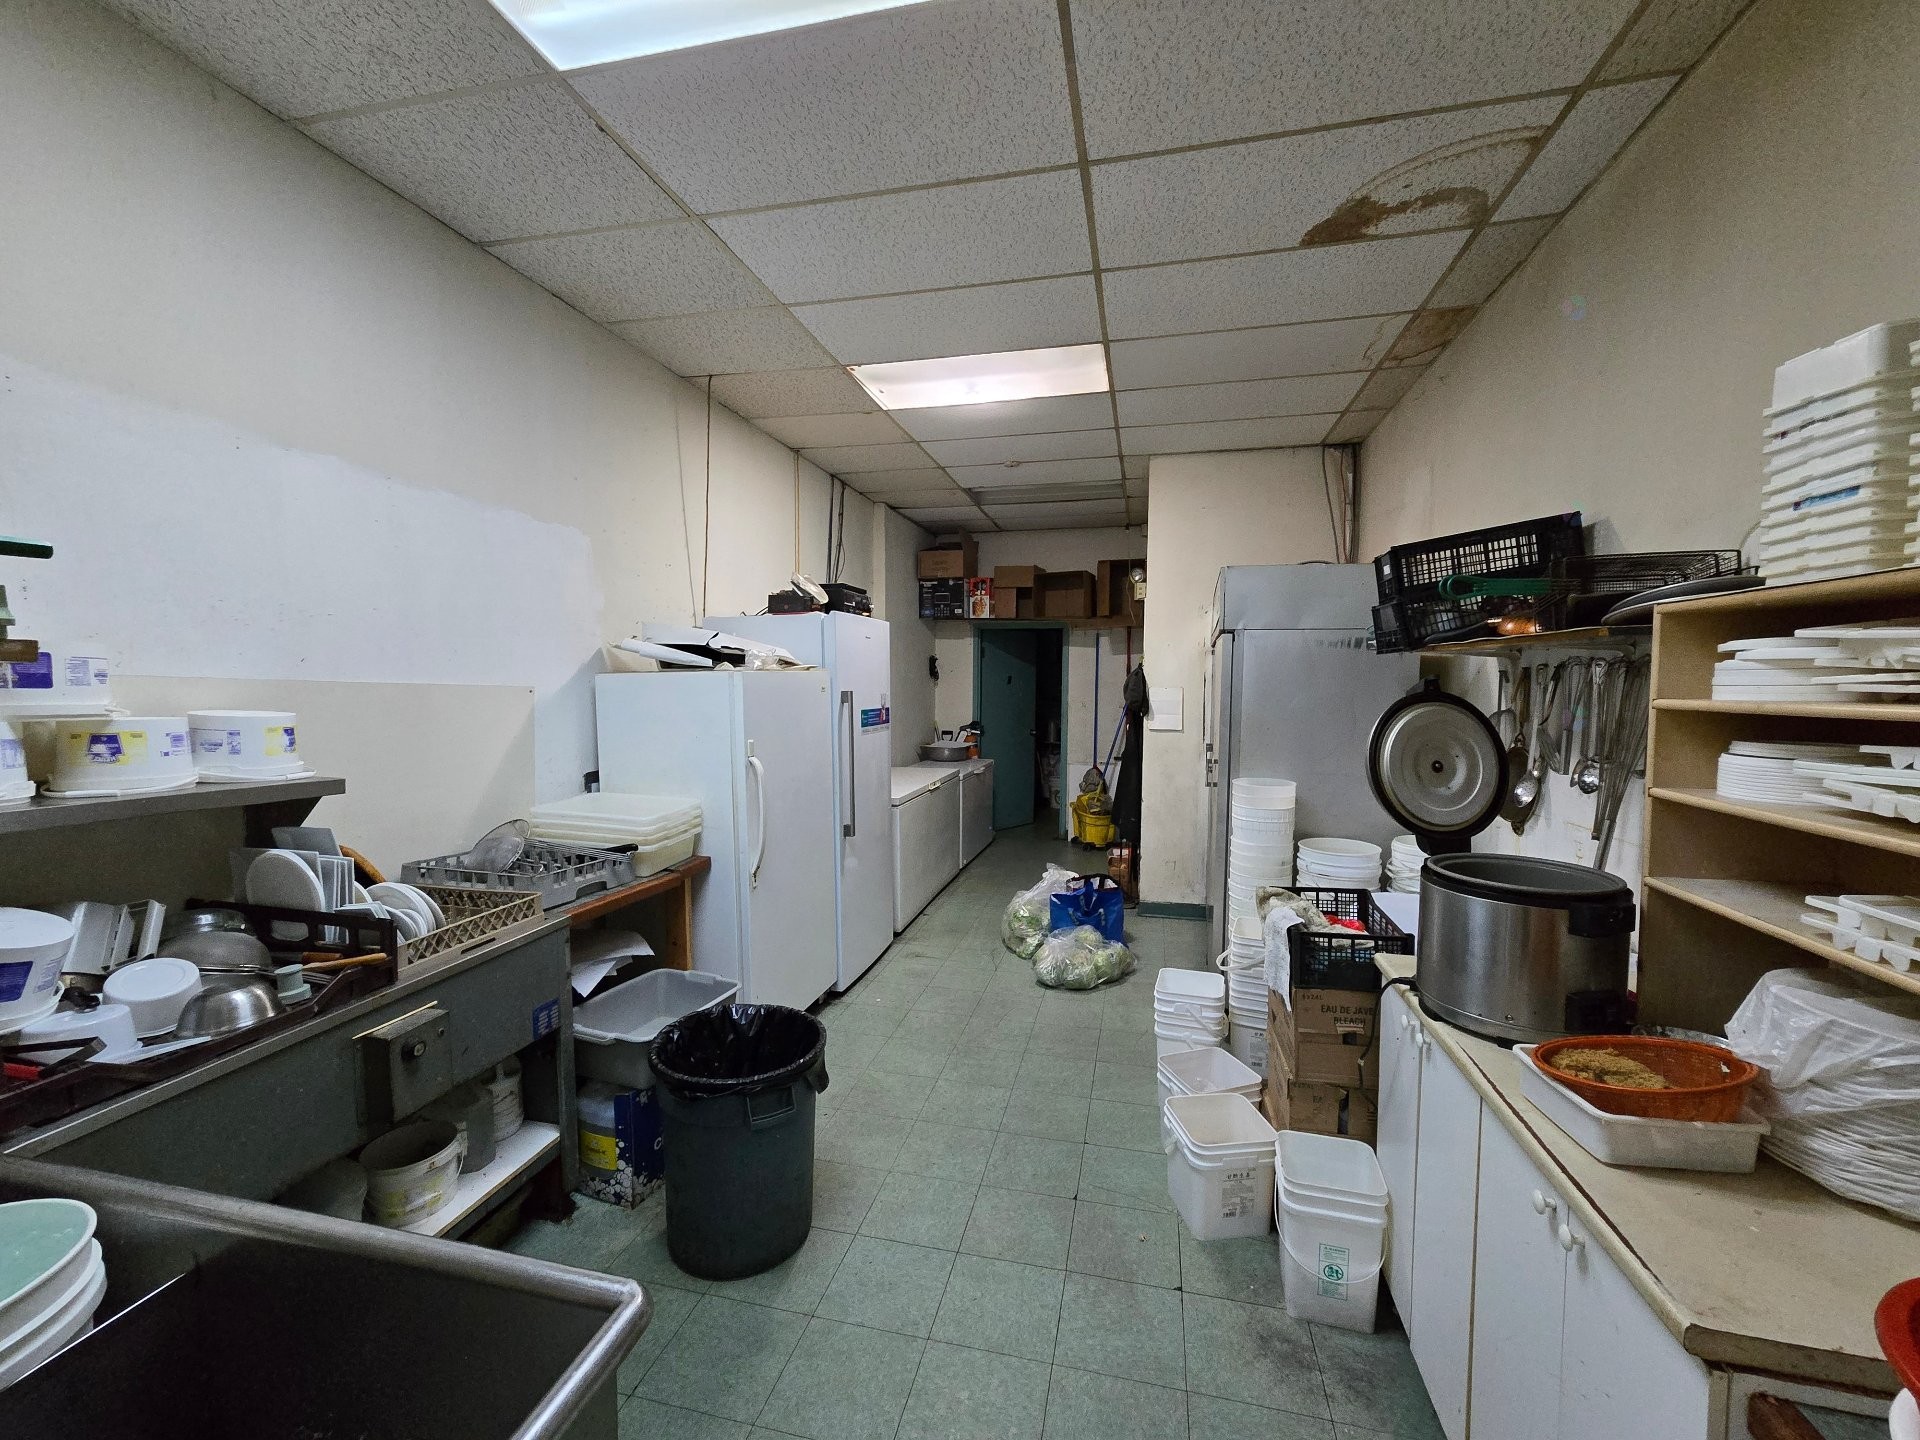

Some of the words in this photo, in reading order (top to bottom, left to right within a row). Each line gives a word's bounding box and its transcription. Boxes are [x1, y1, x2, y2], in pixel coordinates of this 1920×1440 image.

[1321, 1005, 1337, 1013] EAU
[1340, 1006, 1352, 1014] DE
[1353, 1007, 1374, 1016] JAVE
[1333, 1016, 1366, 1026] BLEACH
